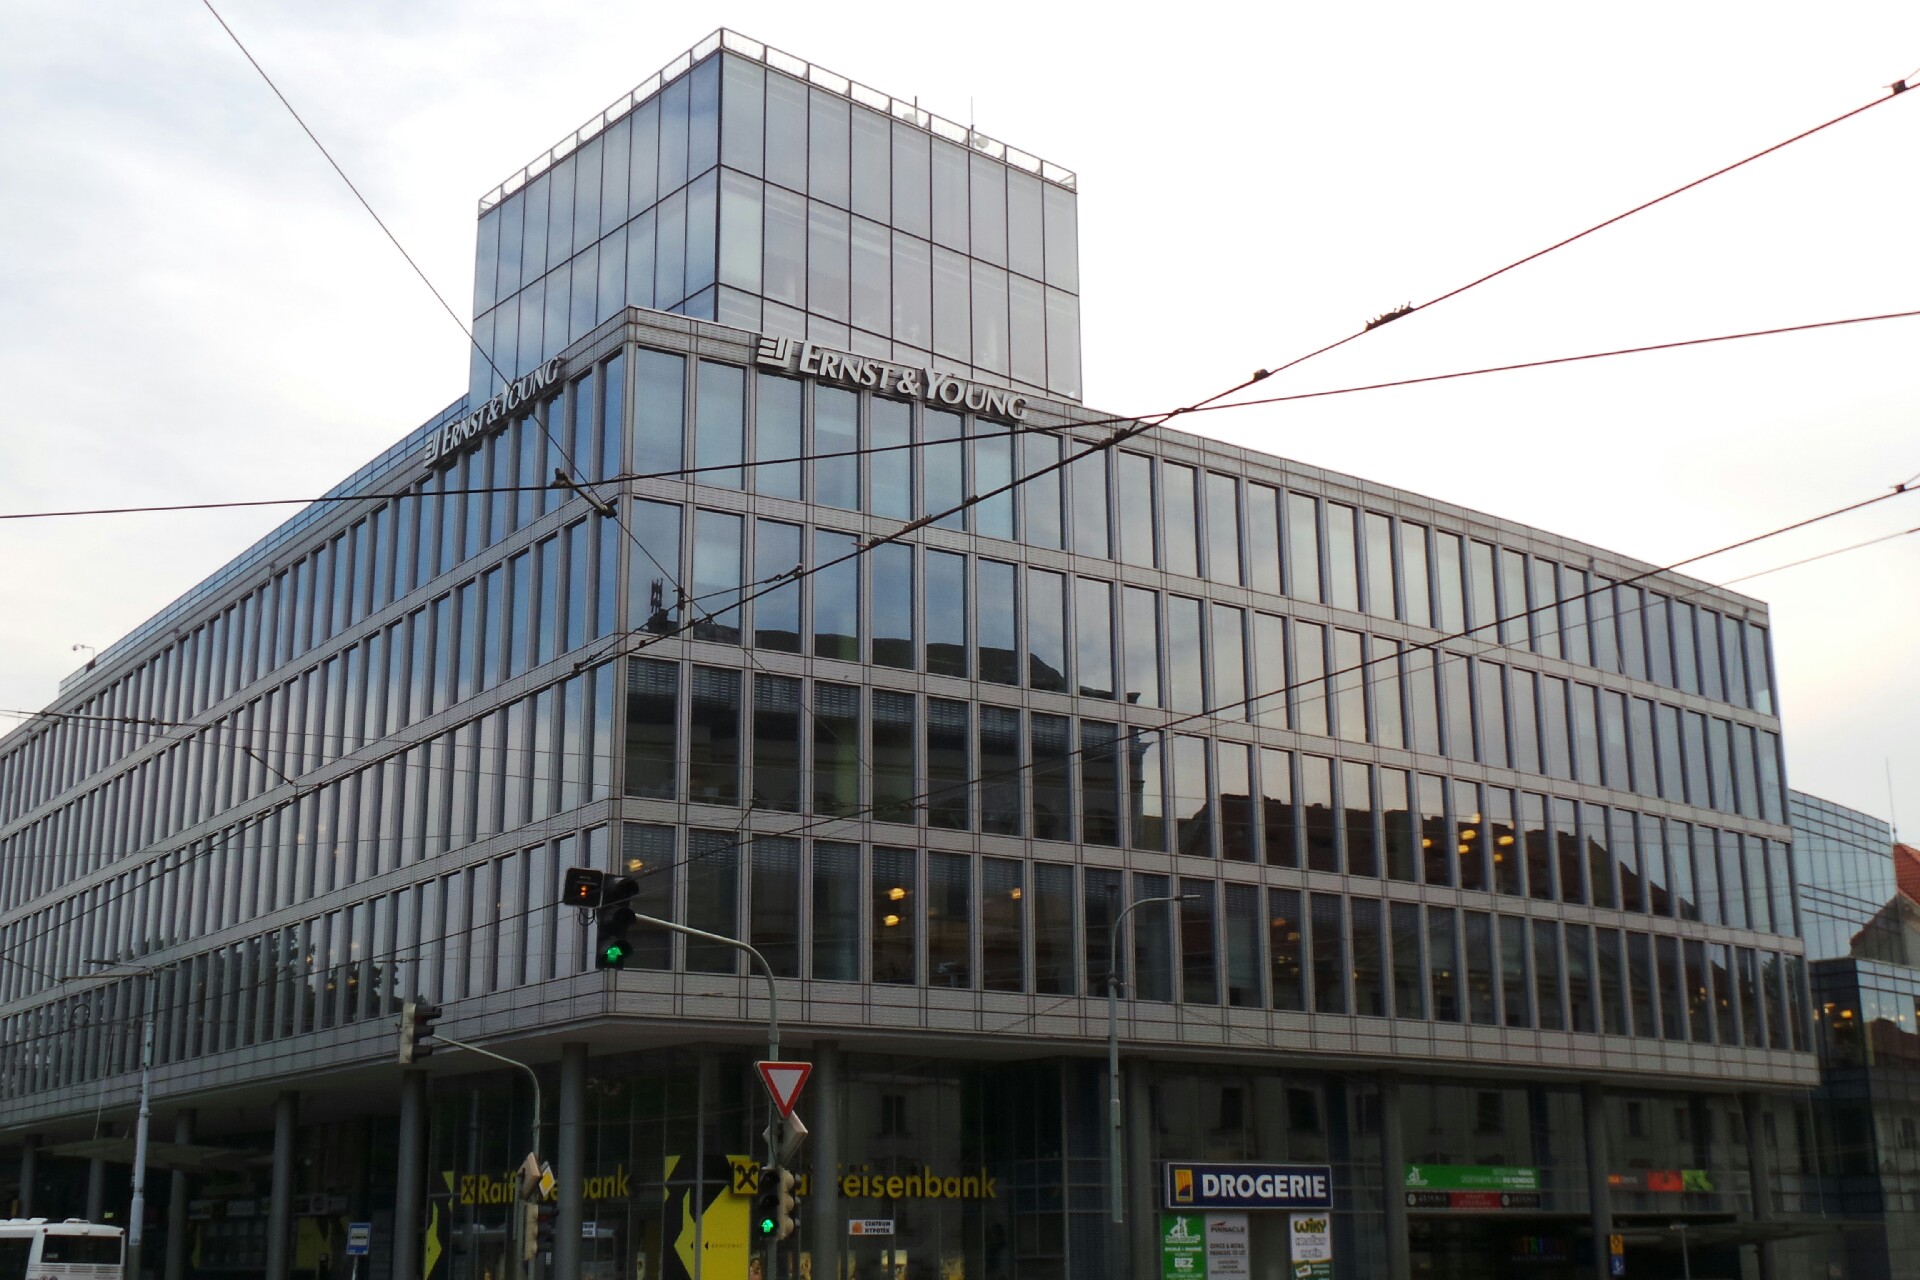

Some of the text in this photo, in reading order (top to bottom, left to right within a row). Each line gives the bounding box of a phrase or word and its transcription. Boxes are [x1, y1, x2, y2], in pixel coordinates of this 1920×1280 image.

[441, 356, 561, 456] ERNST & YOUNG
[799, 340, 1029, 420] ERNST & YOUNG
[1202, 1174, 1327, 1198] DROGERIE
[1174, 1257, 1194, 1268] BEZ
